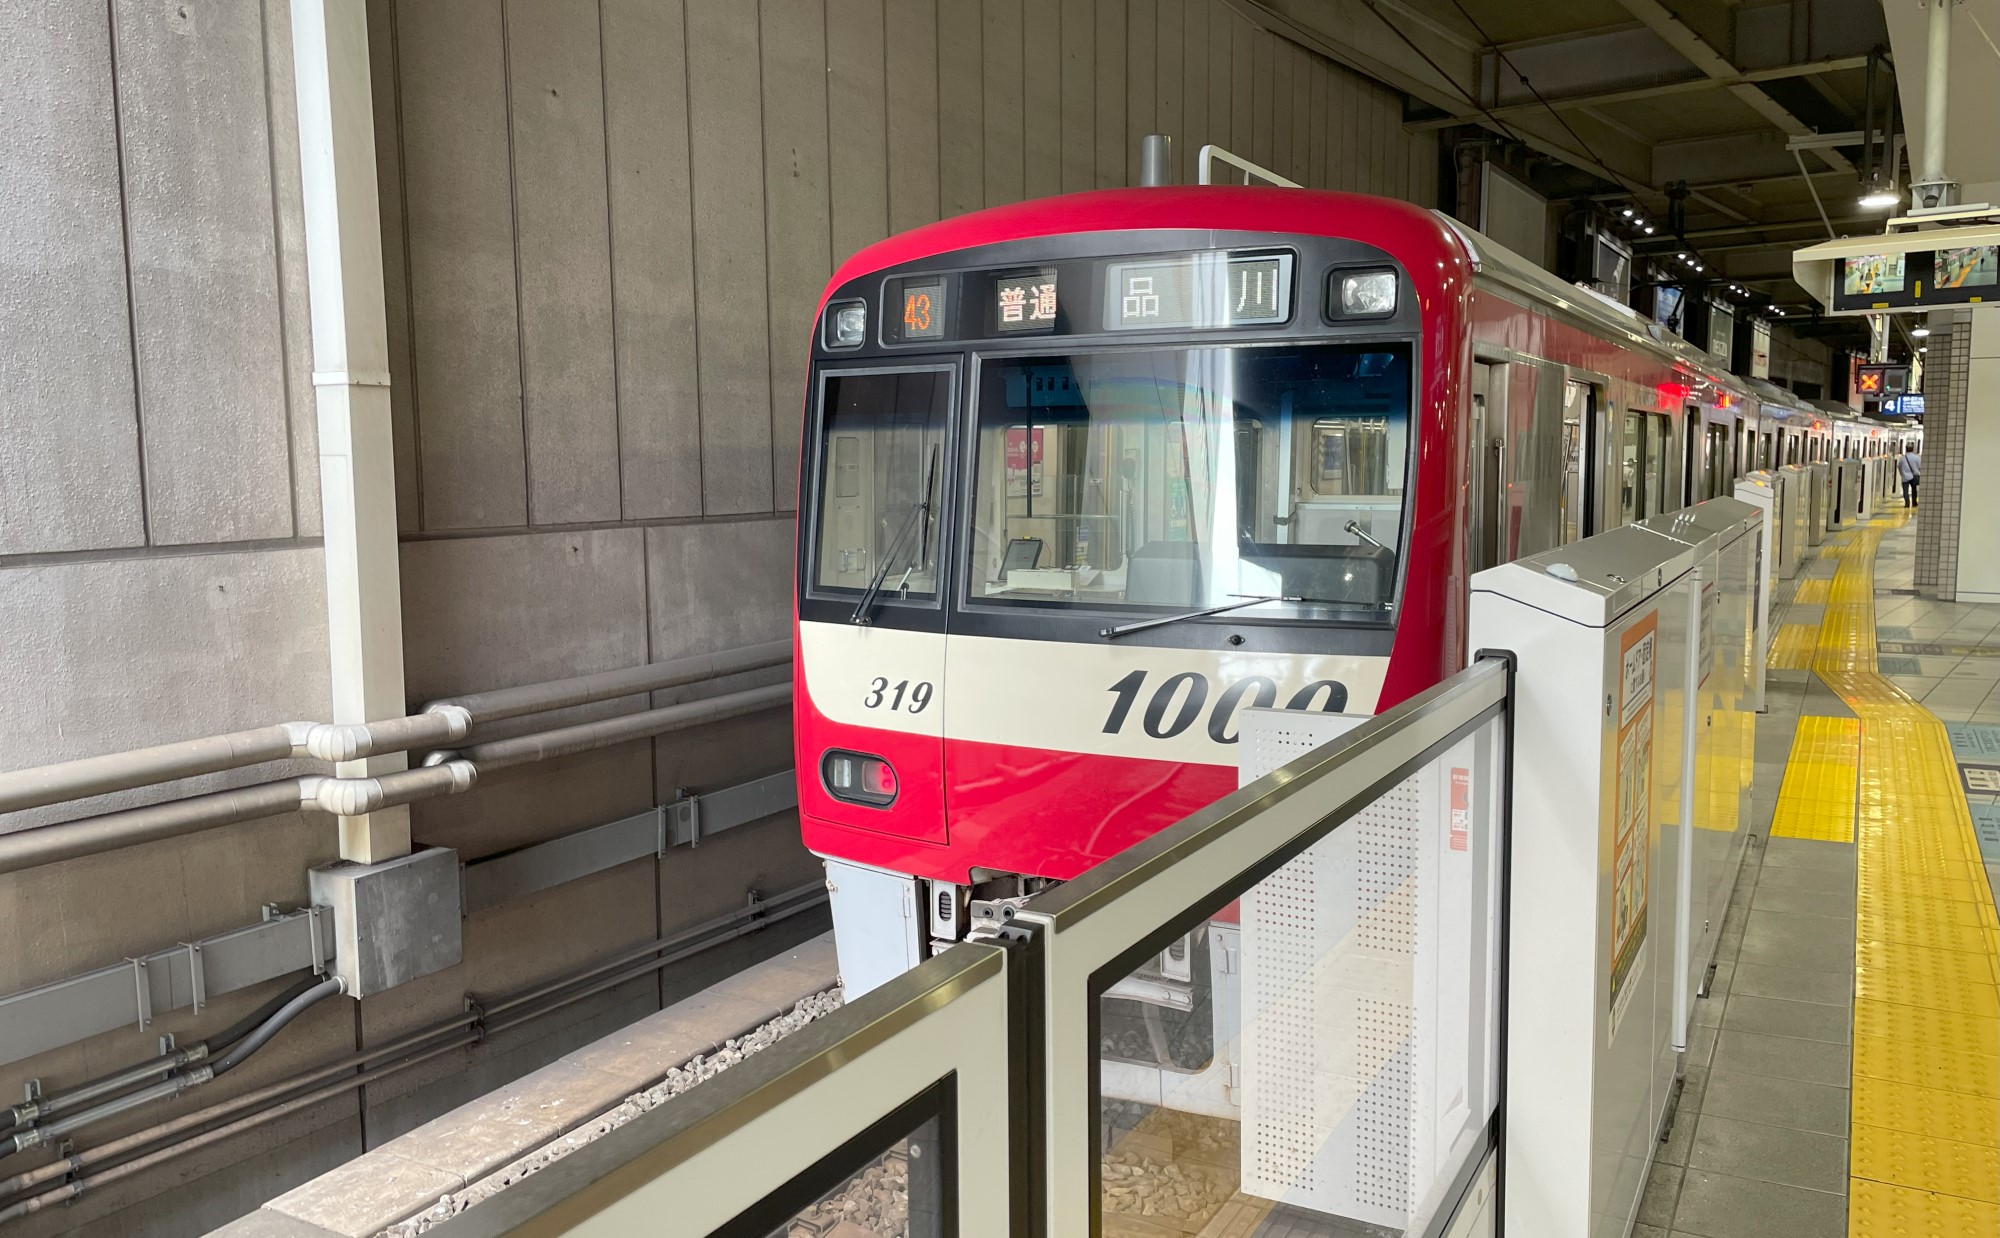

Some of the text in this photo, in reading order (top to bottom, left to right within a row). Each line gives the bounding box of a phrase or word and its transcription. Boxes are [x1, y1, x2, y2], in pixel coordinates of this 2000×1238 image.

[904, 294, 931, 331] 43
[999, 284, 1058, 322] 普通
[1122, 269, 1278, 318] 品川
[1885, 400, 1896, 412] 4
[864, 676, 934, 714] 319
